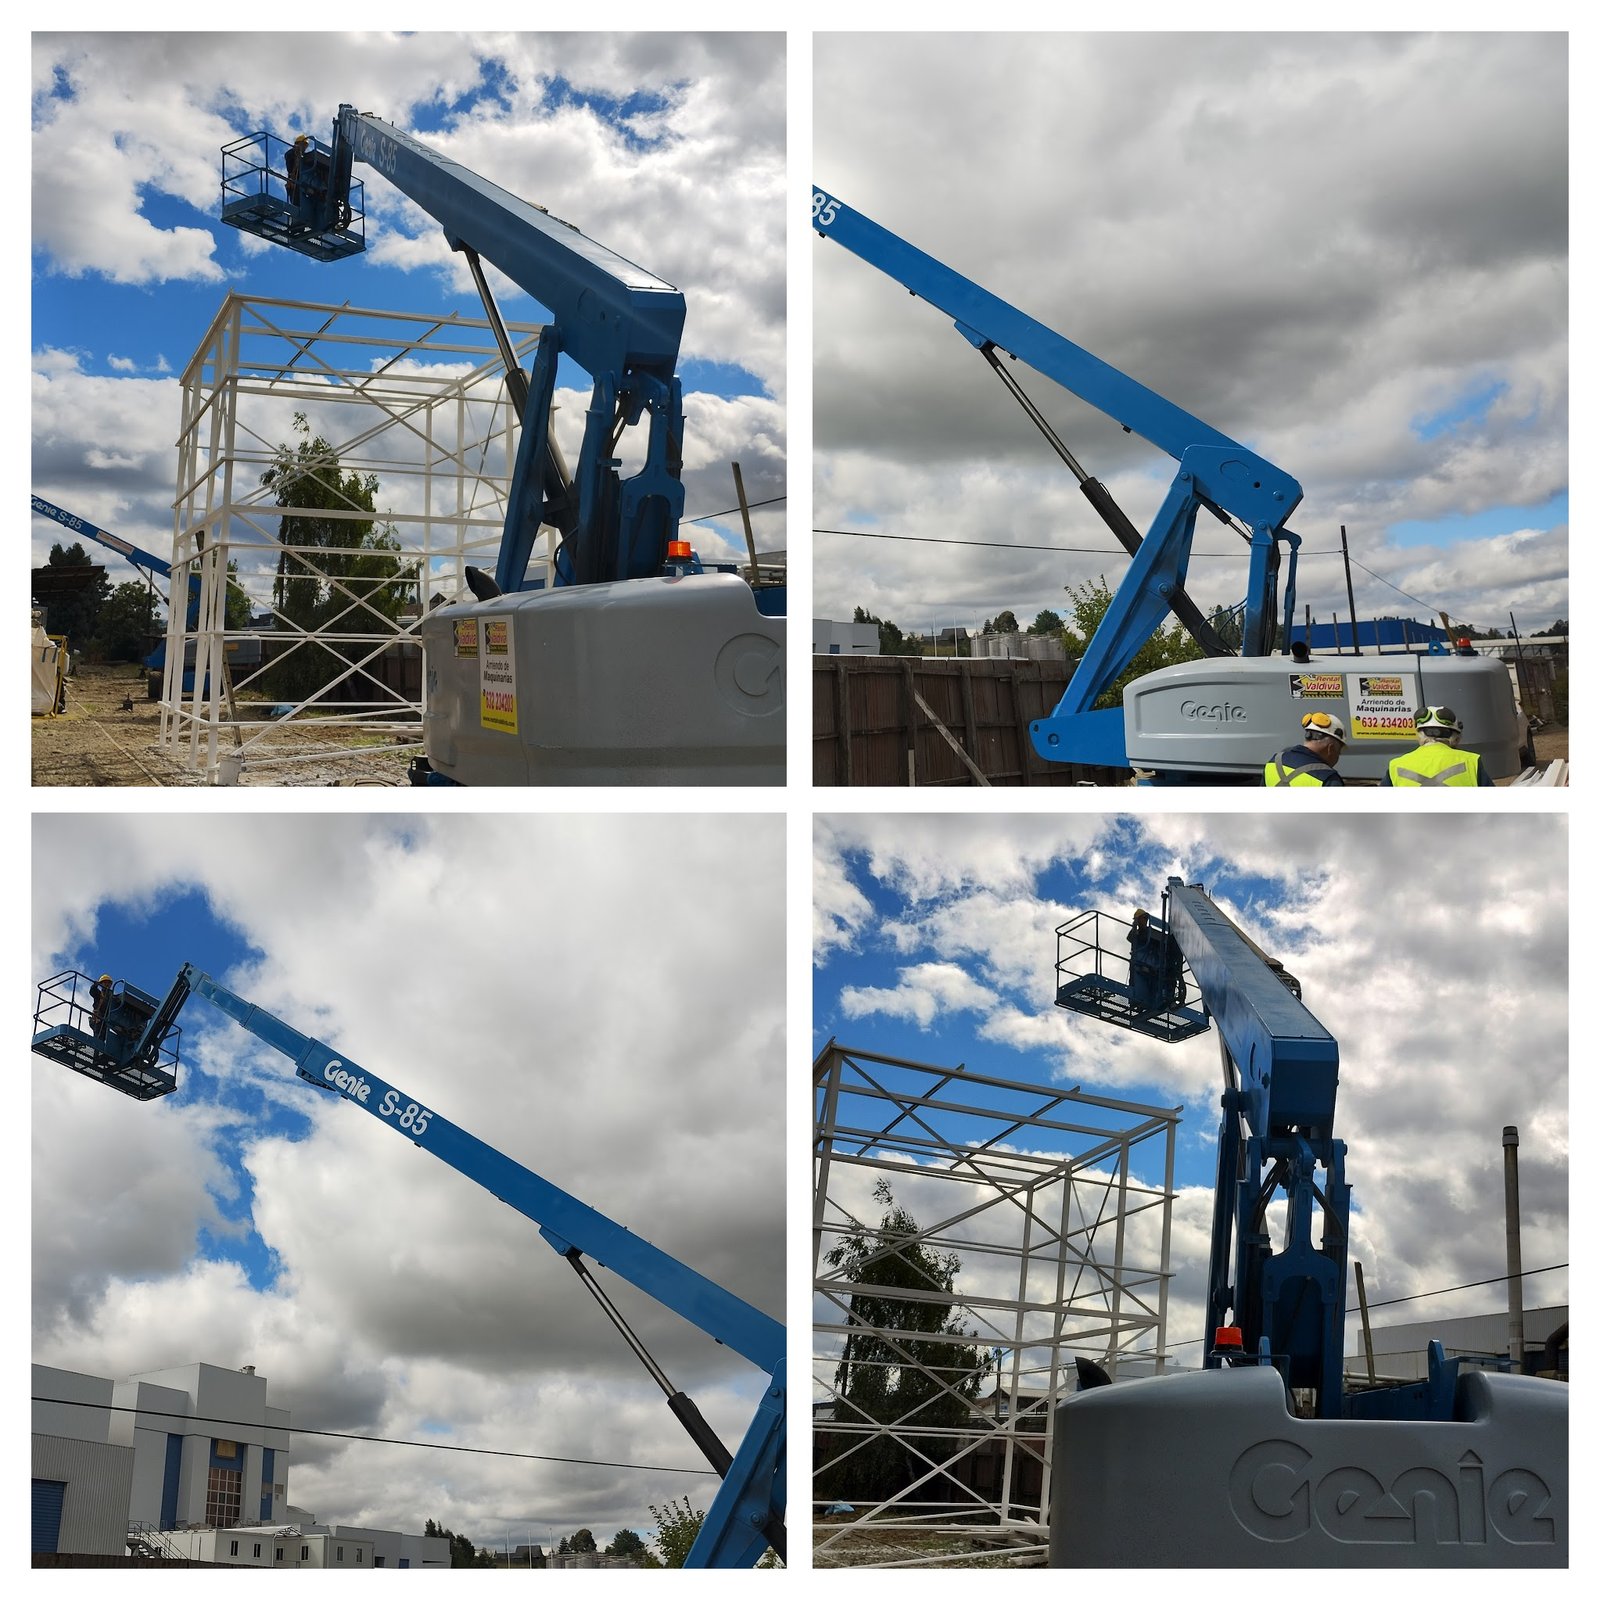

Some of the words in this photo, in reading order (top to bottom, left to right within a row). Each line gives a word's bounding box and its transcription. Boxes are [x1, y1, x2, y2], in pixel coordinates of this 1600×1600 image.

[360, 129, 377, 161] Genie
[379, 137, 398, 174] S-85
[57, 511, 83, 530] S-85
[483, 671, 513, 684] Maquinarias
[1305, 682, 1341, 691] Valdivia
[1180, 700, 1247, 722] Genie
[1356, 704, 1412, 713] Maquinarias
[1361, 716, 1378, 728] 632
[1381, 716, 1414, 729] 234203
[324, 1060, 371, 1102] Genie
[378, 1090, 434, 1136] S-85
[1229, 1438, 1556, 1545] Genie
